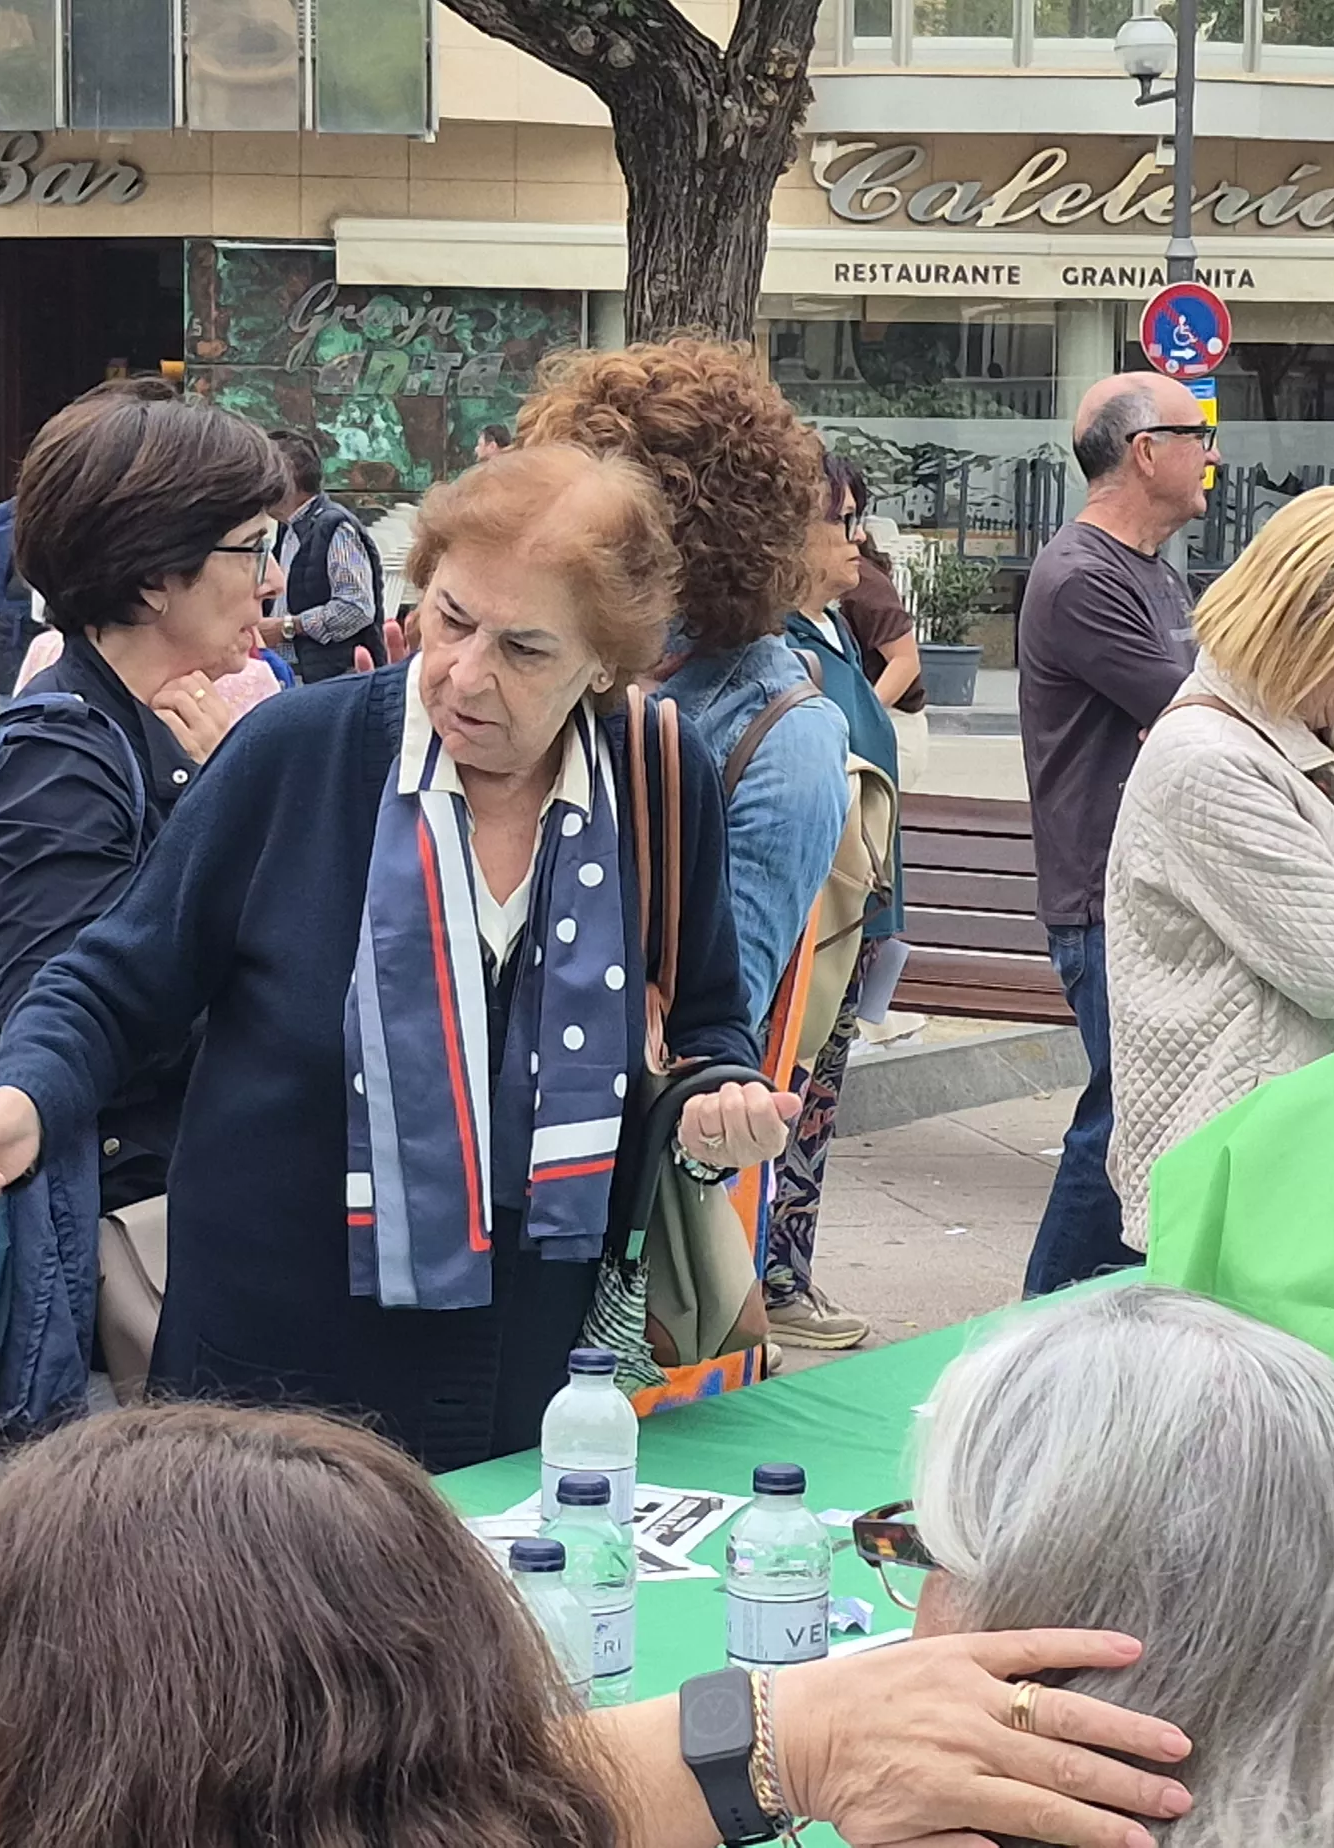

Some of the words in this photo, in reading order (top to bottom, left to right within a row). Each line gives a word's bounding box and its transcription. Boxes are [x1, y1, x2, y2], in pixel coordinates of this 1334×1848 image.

[834, 263, 1021, 286] RESTAURANTE
[1062, 267, 1165, 288] GRANJA
[1195, 269, 1255, 289] NITA
[190, 317, 204, 337] 5
[784, 1622, 828, 1648] VE
